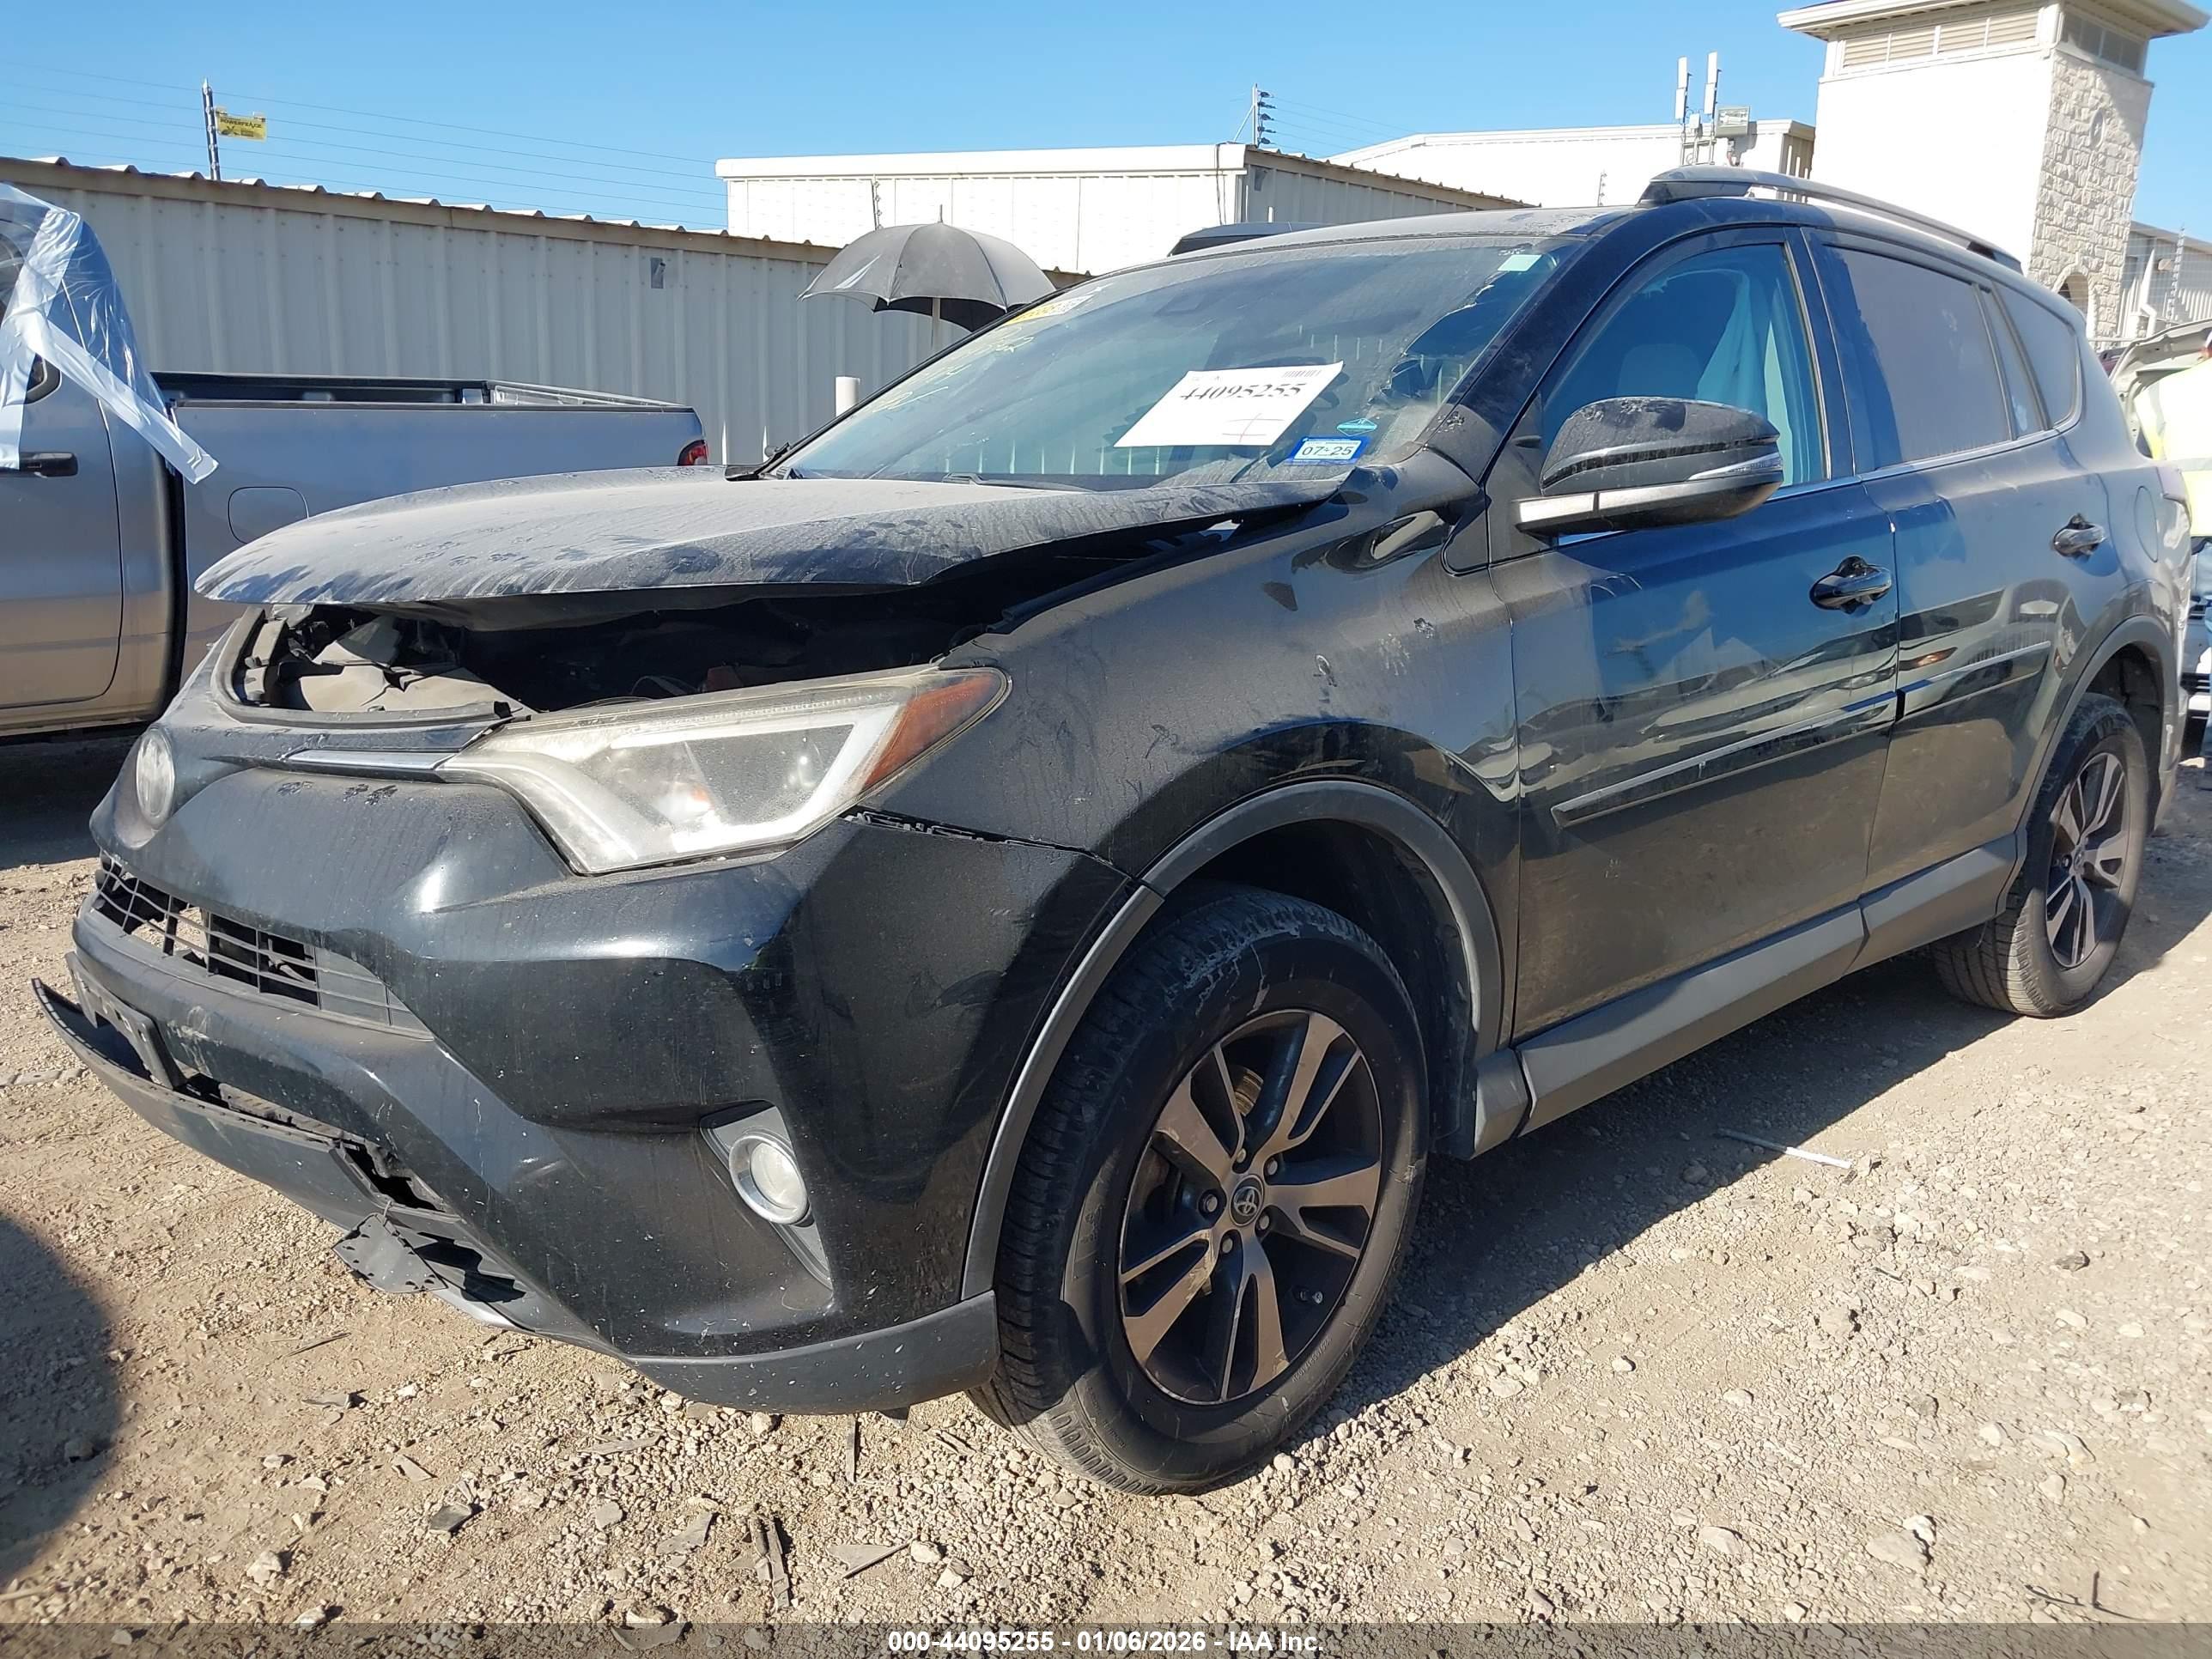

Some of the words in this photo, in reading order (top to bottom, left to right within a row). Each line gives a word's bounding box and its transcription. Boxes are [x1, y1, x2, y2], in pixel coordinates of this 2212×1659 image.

[1180, 383, 1307, 400] 44095255
[1302, 446, 1325, 456] 07
[1330, 446, 1355, 456] 25
